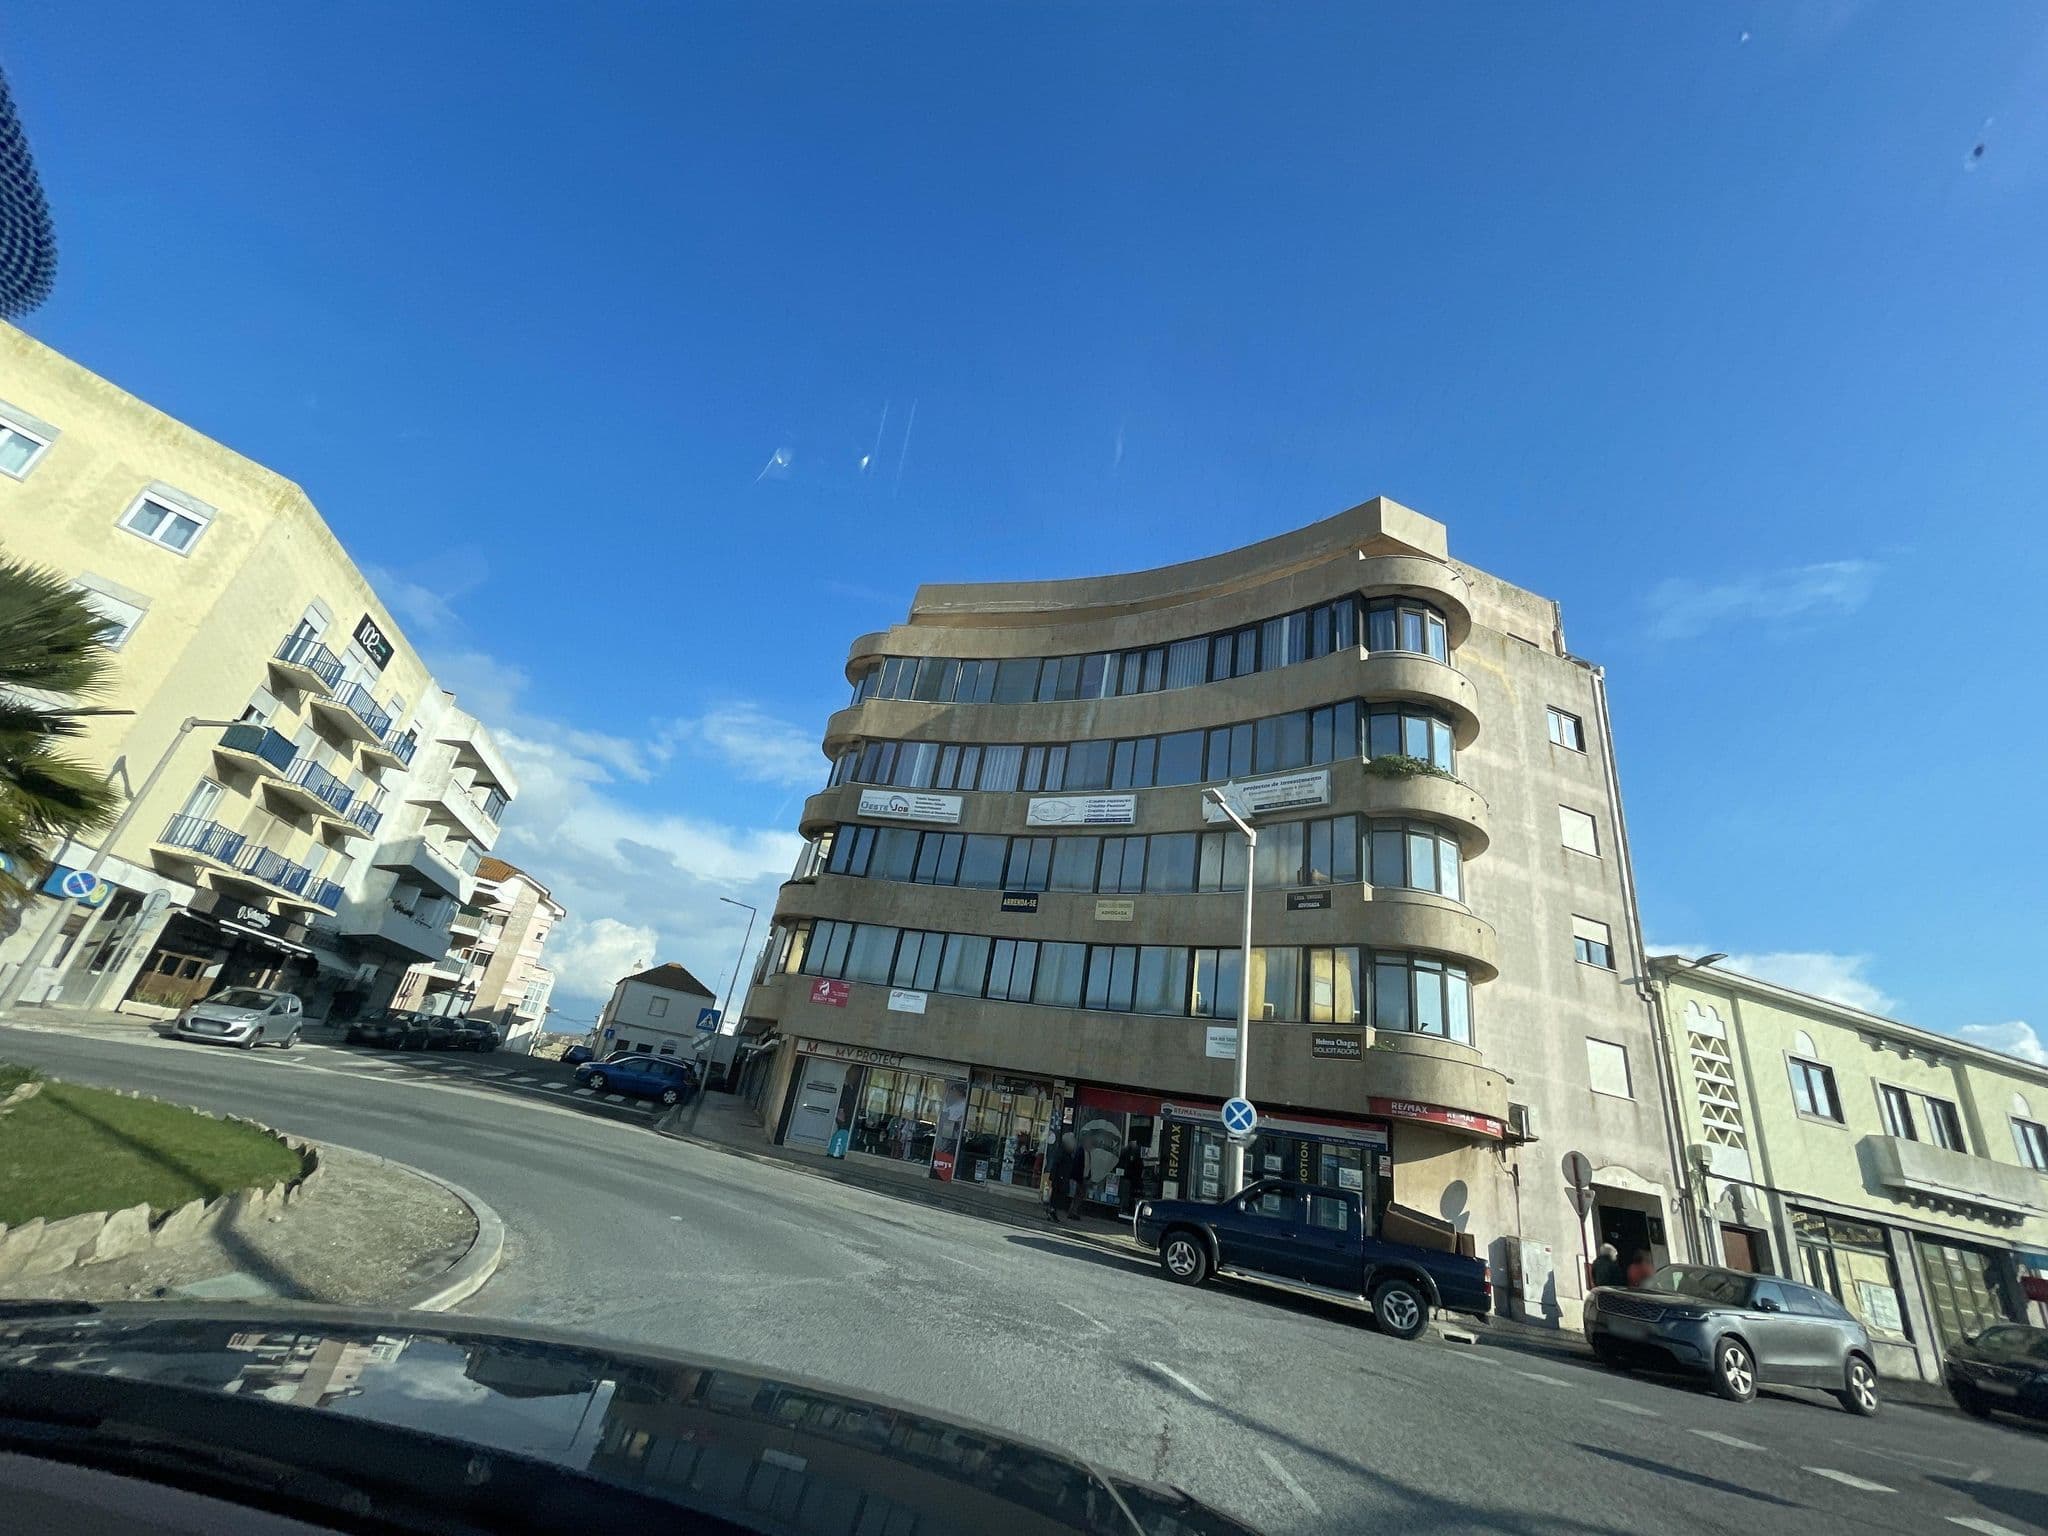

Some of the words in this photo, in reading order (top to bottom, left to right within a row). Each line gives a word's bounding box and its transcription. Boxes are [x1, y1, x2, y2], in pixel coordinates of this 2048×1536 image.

[360, 622, 380, 652] 102
[1003, 898, 1037, 907] ARRENDA-SE
[1336, 1038, 1358, 1049] Chagas
[1314, 1046, 1360, 1055] SOLICITADORA
[856, 1050, 904, 1067] PROTECT
[1391, 1101, 1428, 1114] RE/MAX
[1168, 1124, 1182, 1177] RE/MAX
